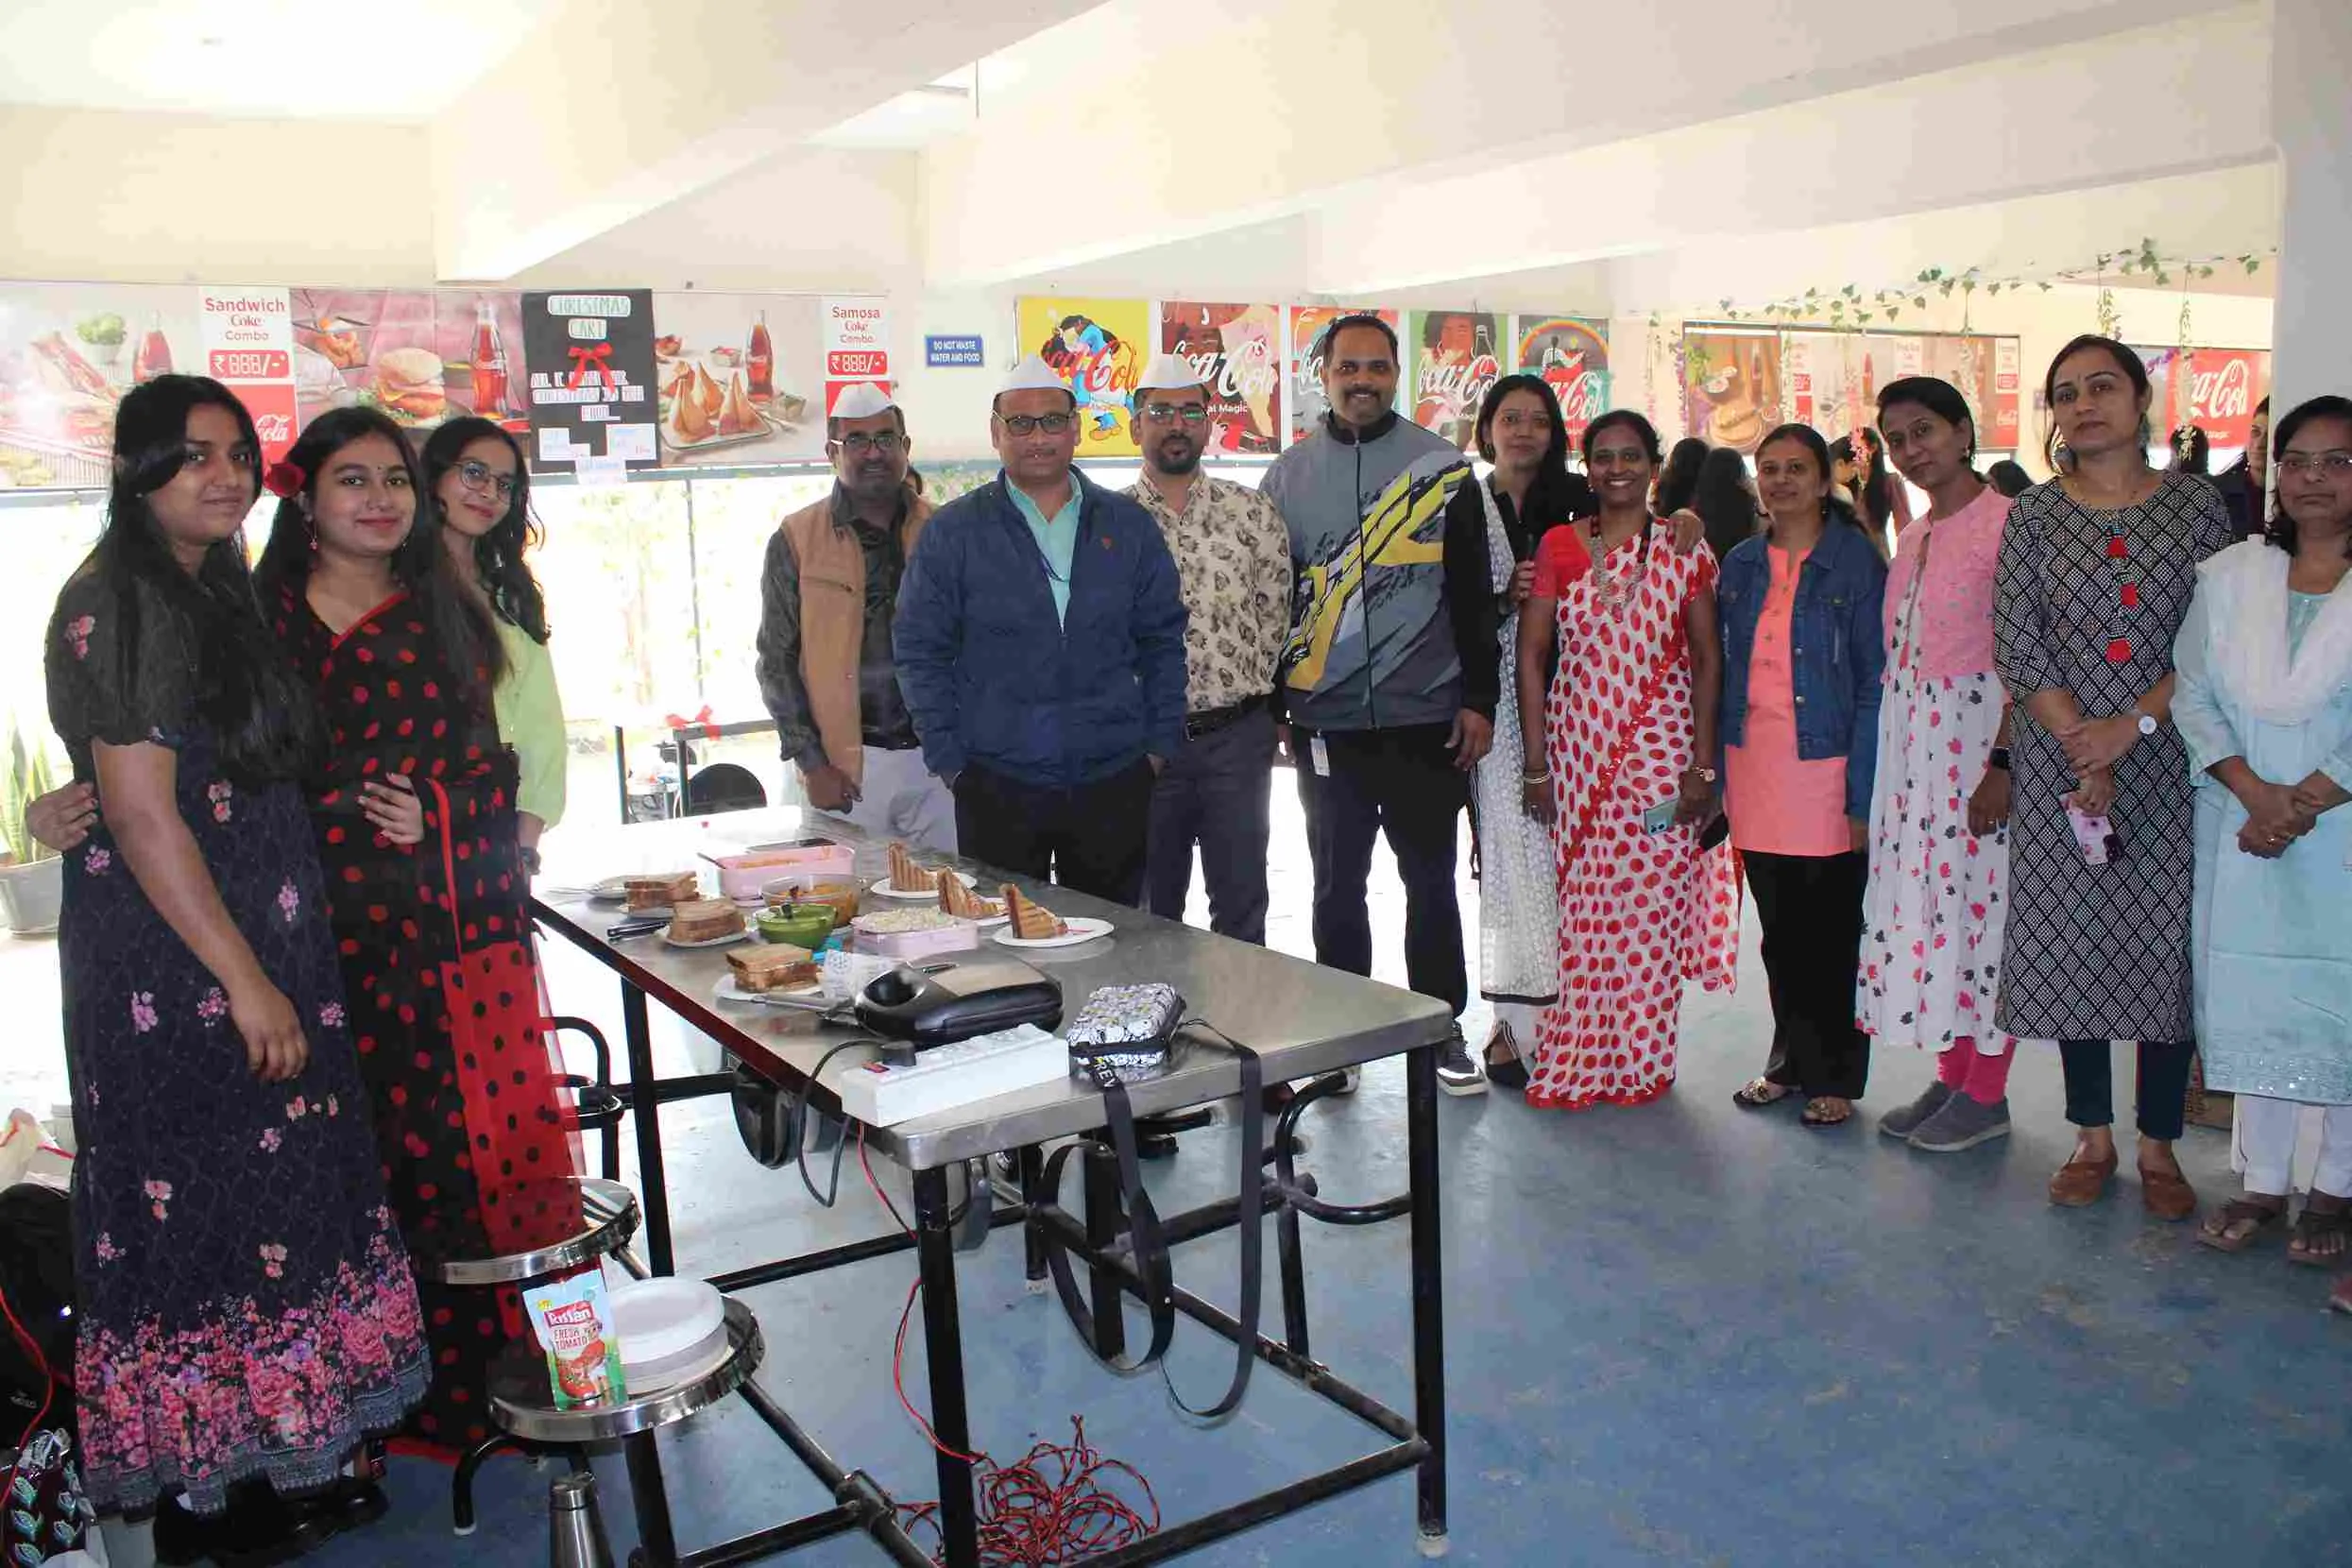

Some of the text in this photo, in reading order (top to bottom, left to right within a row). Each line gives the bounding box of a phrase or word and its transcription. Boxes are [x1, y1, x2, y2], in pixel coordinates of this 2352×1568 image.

[205, 297, 285, 312] Sandwich
[832, 306, 880, 318] Samosa
[230, 315, 262, 327] Coke
[225, 331, 269, 342] Combo
[840, 332, 876, 344] Combo
[943, 340, 955, 349] NOT
[1219, 401, 1248, 416] Magic
[554, 1328, 580, 1340] FRESH
[555, 1336, 588, 1351] TOMATO
